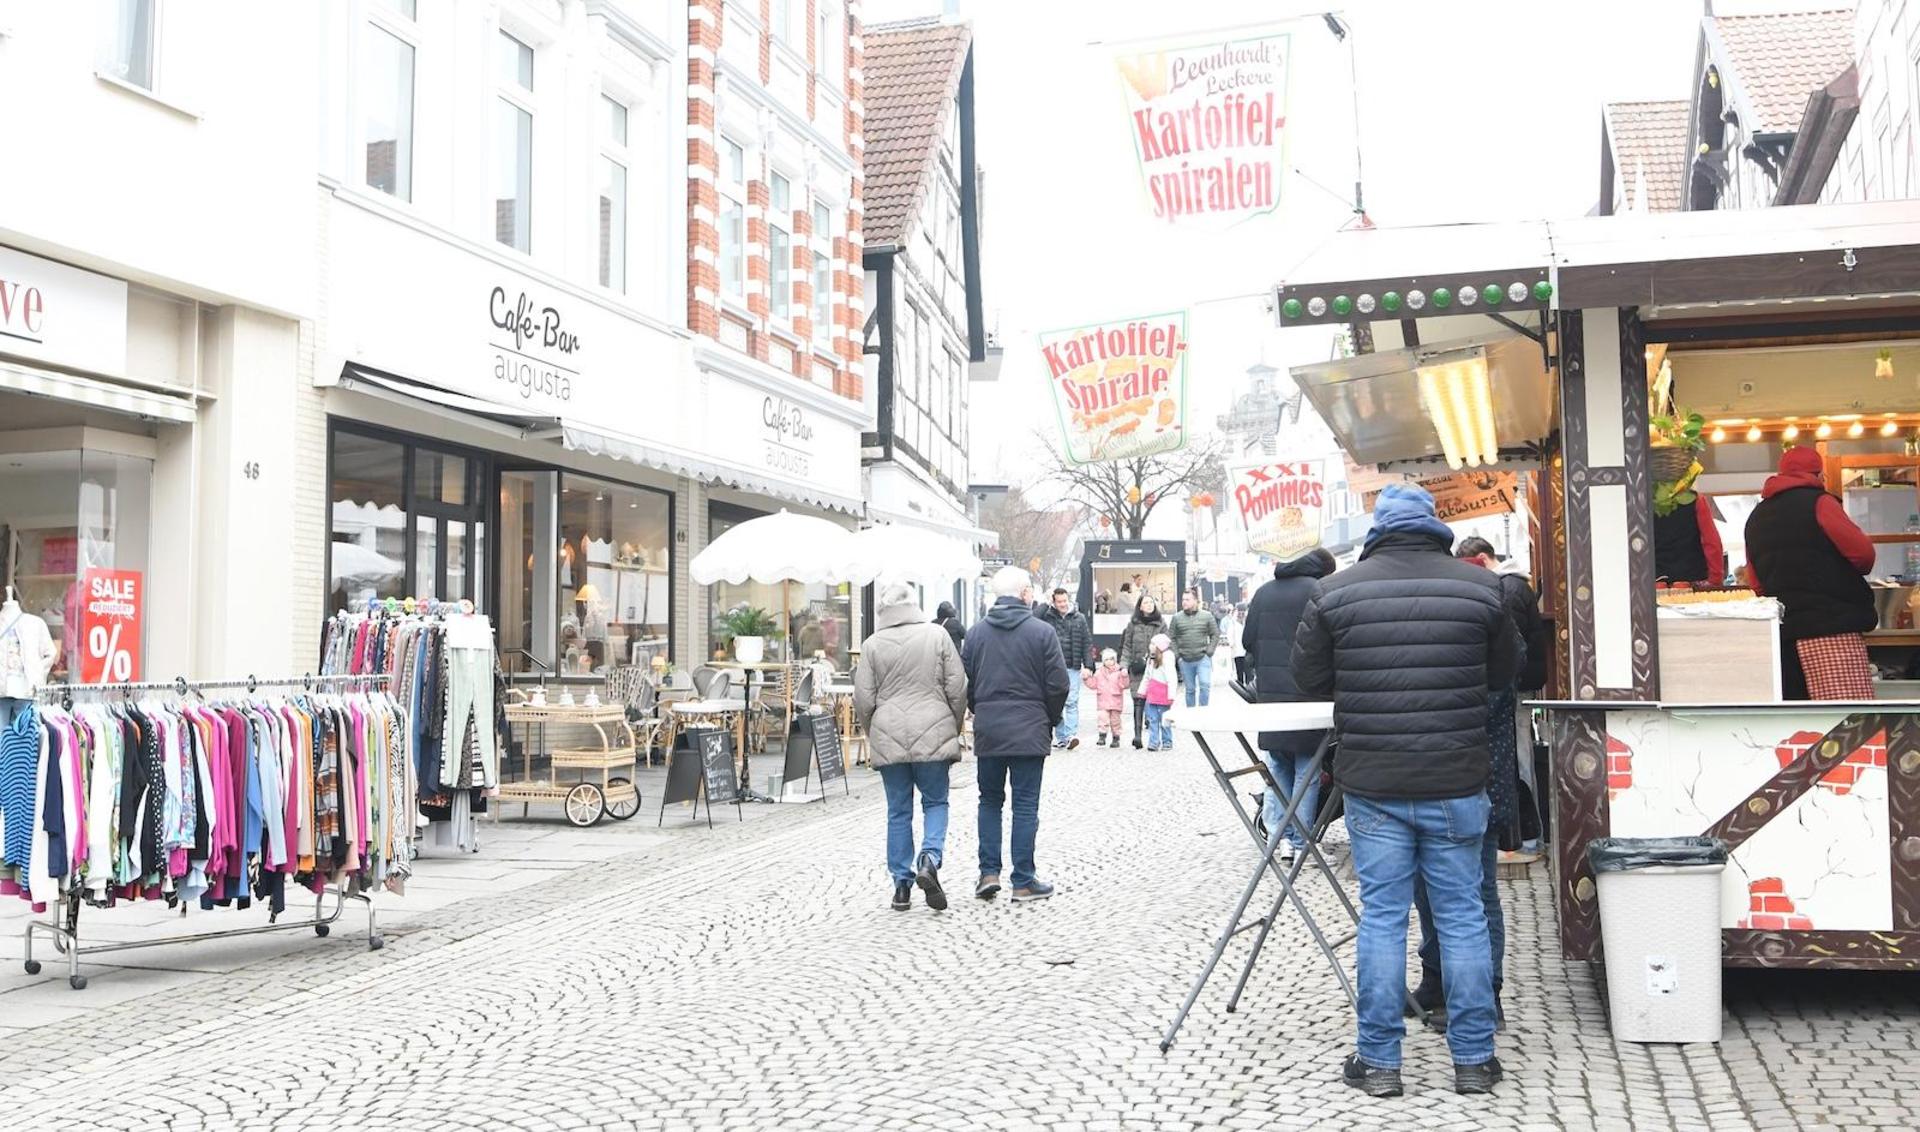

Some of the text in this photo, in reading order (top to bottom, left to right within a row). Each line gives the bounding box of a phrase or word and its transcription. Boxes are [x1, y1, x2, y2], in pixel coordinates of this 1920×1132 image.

[1170, 41, 1282, 94] Leonhardt's
[1206, 68, 1273, 97] Leckere
[1134, 92, 1287, 162] Kartoffel-
[1150, 156, 1273, 224] spiralen
[489, 286, 581, 355] Café-Bar
[1042, 322, 1187, 379] Kartoffel-
[495, 355, 571, 401] augusta
[1062, 364, 1168, 415] Spirale
[763, 396, 813, 442] Café-Bar
[766, 446, 808, 477] augusta
[1235, 480, 1323, 531] Pommes
[91, 577, 135, 600] SALE
